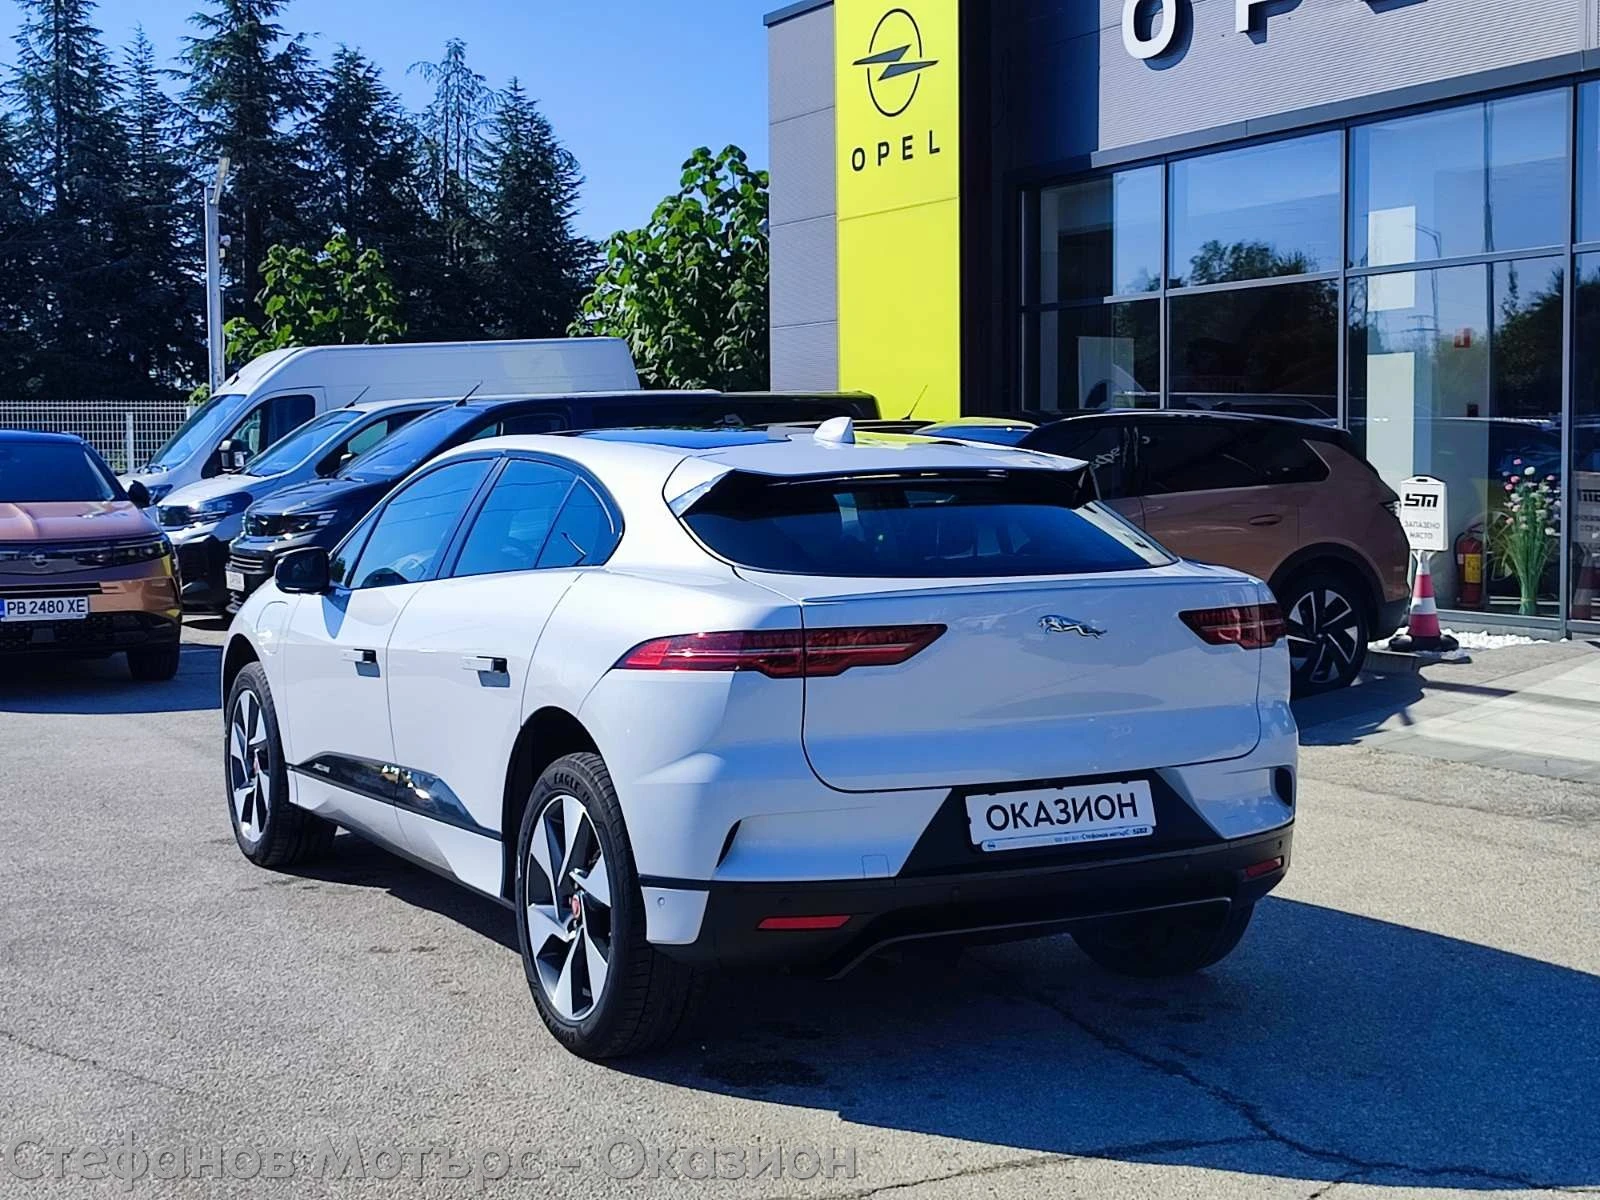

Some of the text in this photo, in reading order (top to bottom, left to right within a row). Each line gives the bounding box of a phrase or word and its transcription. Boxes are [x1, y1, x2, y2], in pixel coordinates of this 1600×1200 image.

[851, 129, 941, 172] OPEL
[6, 598, 86, 615] PB 2480 XE
[985, 792, 1138, 831] ОКАЗИОН
